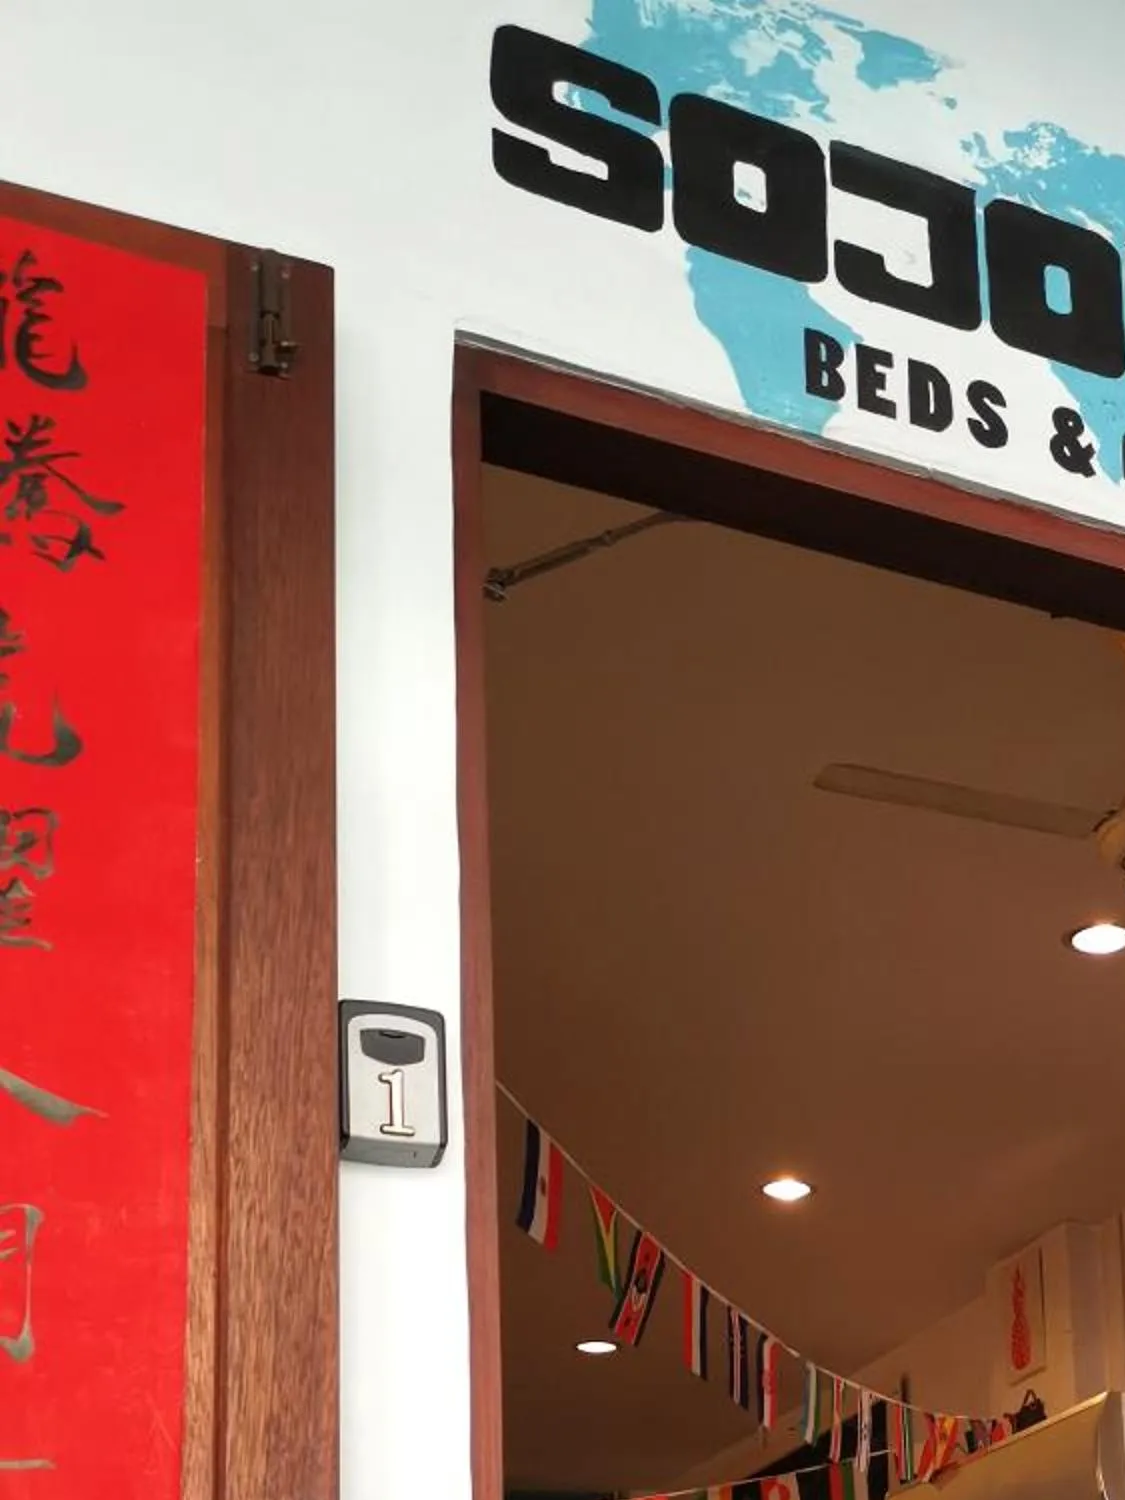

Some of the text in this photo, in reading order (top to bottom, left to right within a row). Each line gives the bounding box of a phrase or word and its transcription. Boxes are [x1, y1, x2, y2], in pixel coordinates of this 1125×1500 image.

[804, 327, 1008, 450] BEDS
[1050, 406, 1096, 480] &
[378, 1068, 417, 1138] 1
